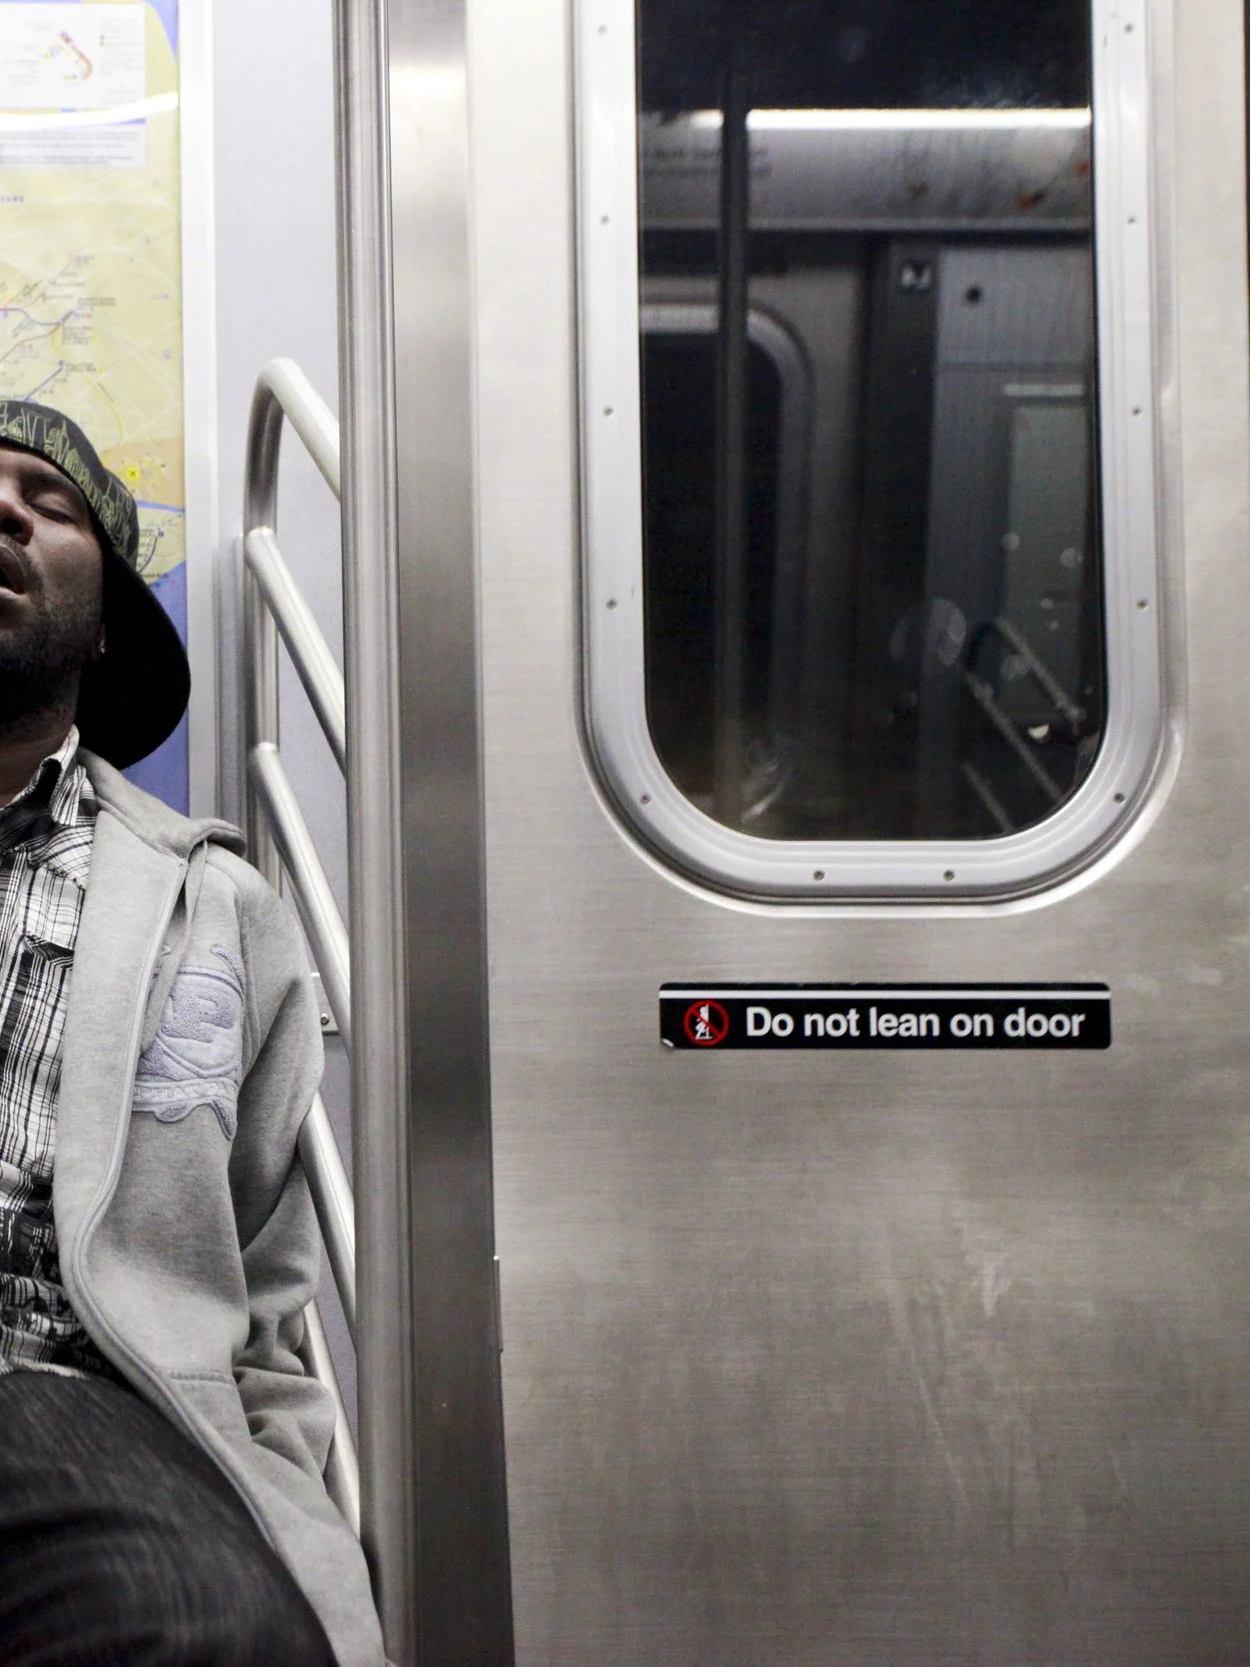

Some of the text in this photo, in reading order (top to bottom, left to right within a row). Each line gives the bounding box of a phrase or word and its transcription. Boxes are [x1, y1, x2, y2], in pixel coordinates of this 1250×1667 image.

[746, 1006, 1086, 1037] Do not lean on door
